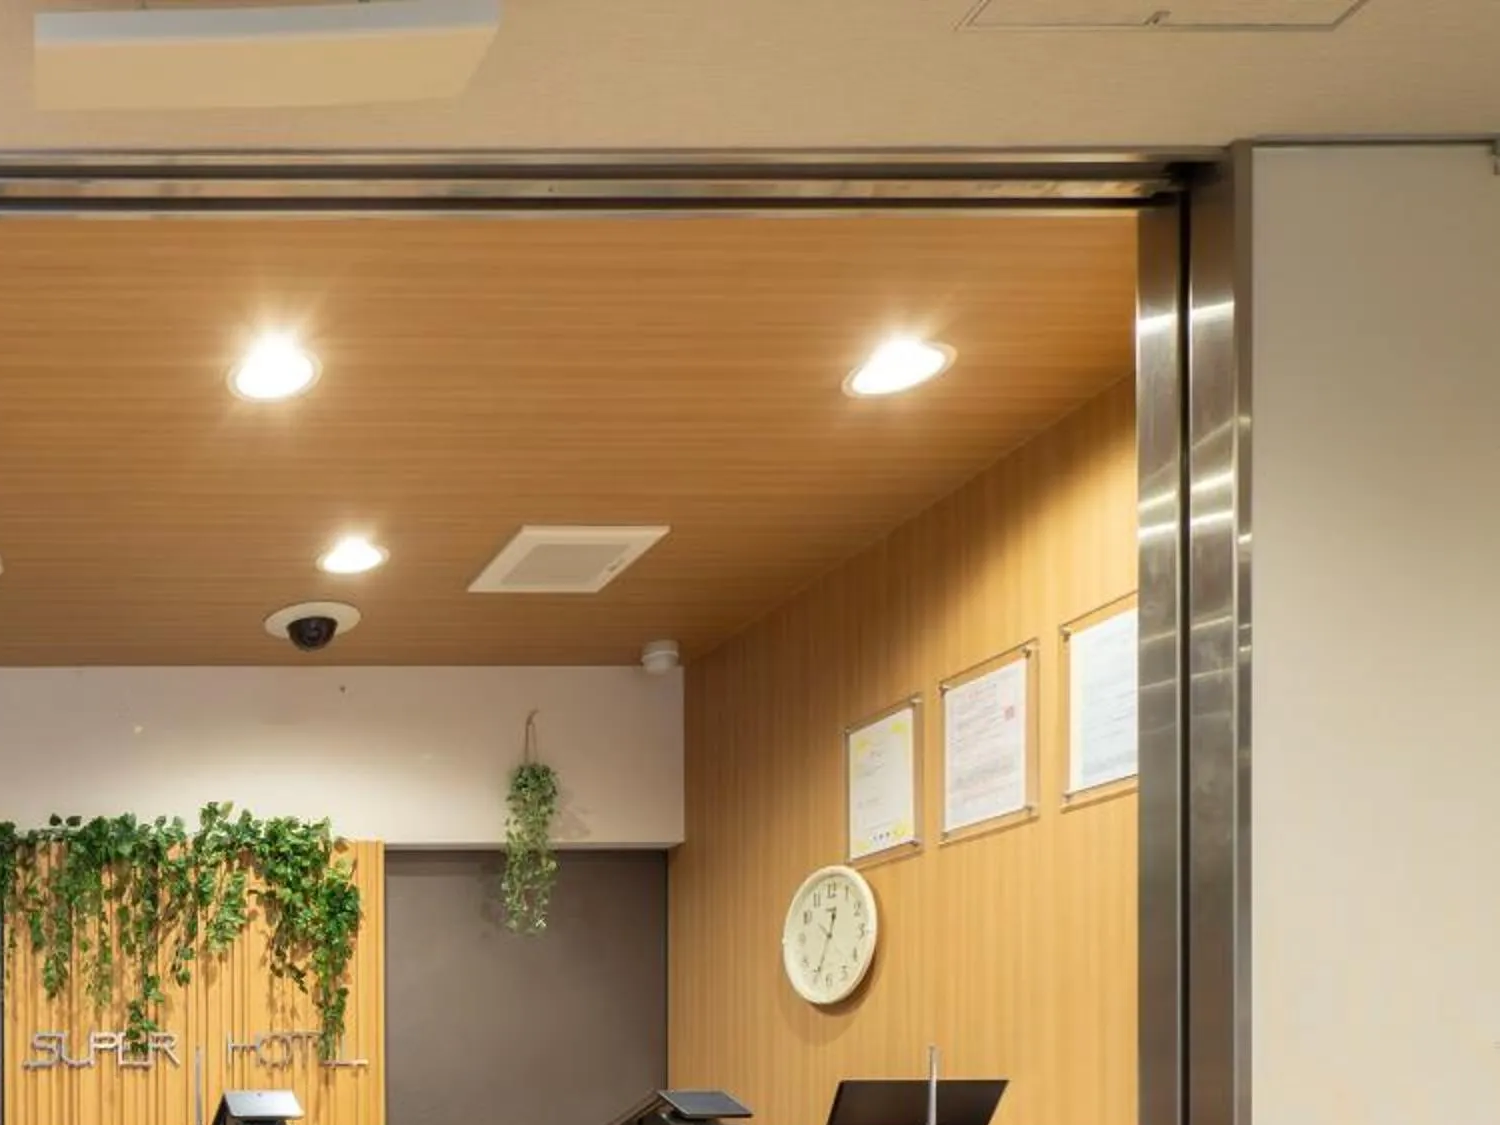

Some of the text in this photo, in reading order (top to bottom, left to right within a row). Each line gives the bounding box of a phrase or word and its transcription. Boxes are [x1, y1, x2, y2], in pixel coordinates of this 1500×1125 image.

[826, 881, 837, 899] 12
[813, 891, 821, 908] 11
[853, 901, 861, 917] 2
[857, 922, 866, 940] 3
[23, 1031, 181, 1069] SUPER
